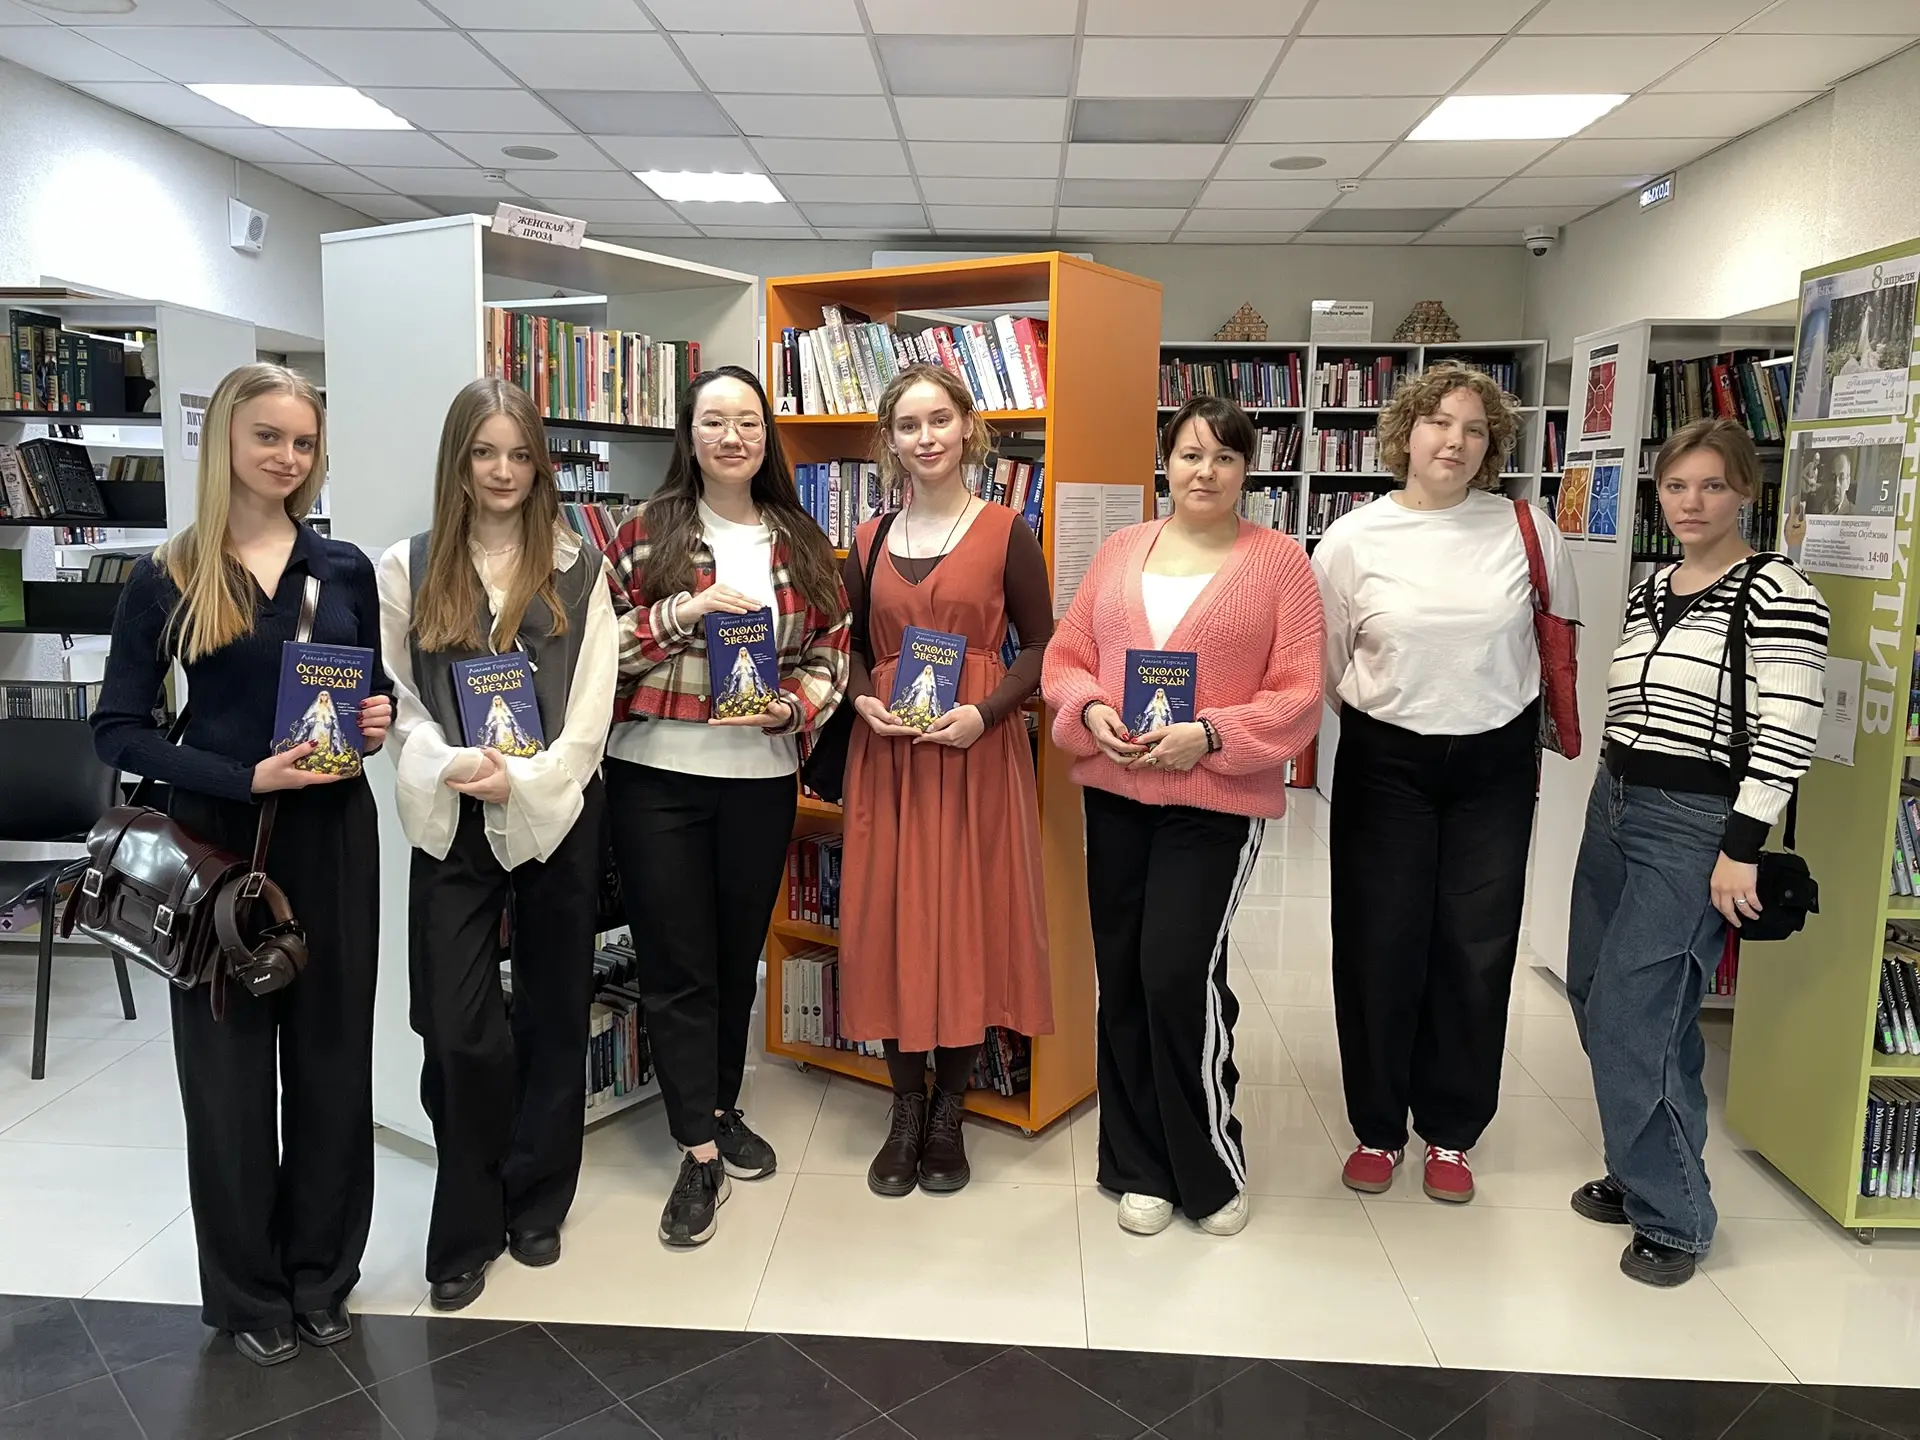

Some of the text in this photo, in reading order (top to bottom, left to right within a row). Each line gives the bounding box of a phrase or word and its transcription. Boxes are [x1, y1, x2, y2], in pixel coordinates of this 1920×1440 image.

[518, 216, 564, 232] ЖЕНСКАЯ
[523, 229, 553, 241] ПРОЗА
[1872, 265, 1915, 289] 8 апреля
[586, 466, 594, 491] ПЕТЛЯ
[1879, 480, 1889, 501] 5
[1868, 552, 1889, 562] 14:00
[718, 624, 768, 637] ОСКОЛОК
[724, 633, 765, 646] ЗВЕЗДЫ
[912, 642, 958, 658] ОСКОЛОК
[329, 654, 360, 664] Горская
[914, 651, 953, 666] ЗВЕЗДЫ
[296, 662, 363, 679] ОСКОЛОК
[467, 669, 525, 686] ОСКОЛОК
[1137, 665, 1190, 677] ОСКОЛОК
[301, 675, 357, 689] ЗВЕЗДЫ
[474, 680, 522, 695] ЗВЕЗДЫ
[1142, 675, 1185, 686] ЗВЕЗДЫ
